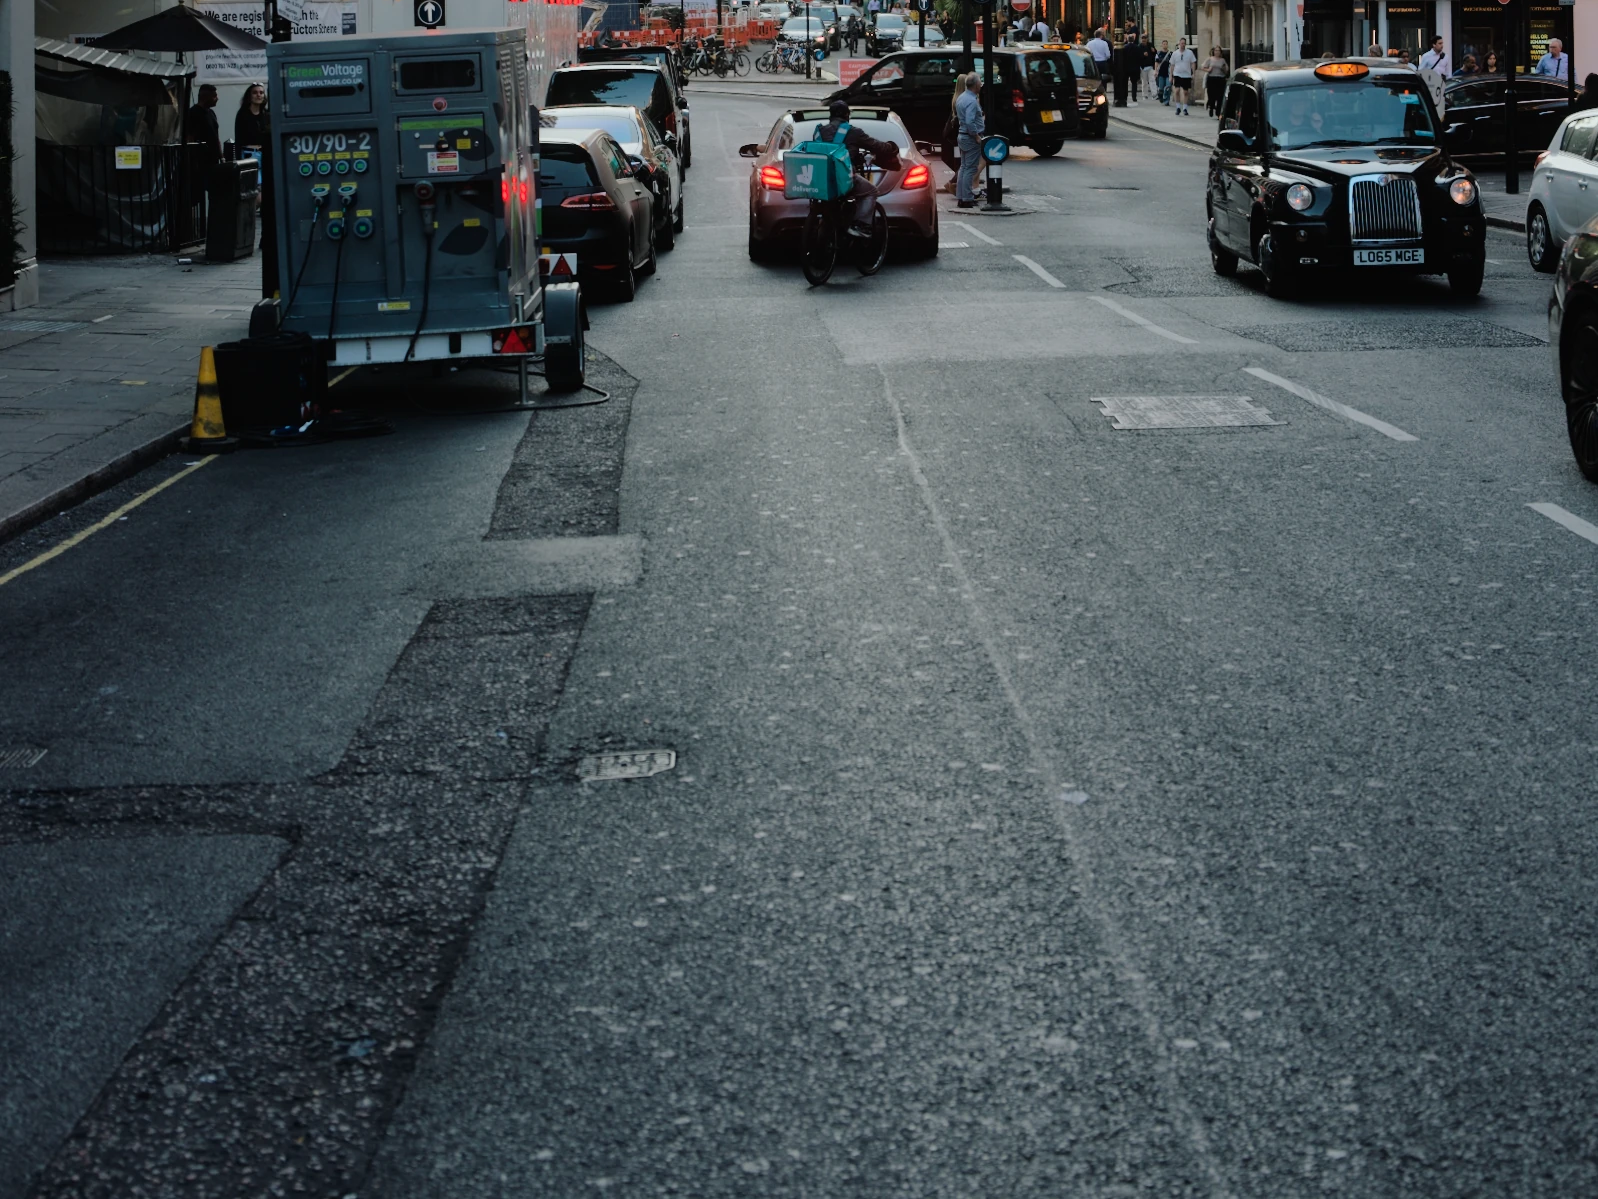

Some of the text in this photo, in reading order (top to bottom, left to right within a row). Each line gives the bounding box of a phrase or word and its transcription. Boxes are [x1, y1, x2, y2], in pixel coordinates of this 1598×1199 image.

[222, 13, 237, 21] are
[309, 10, 319, 20] the
[288, 64, 363, 78] GreenVoltage
[1328, 66, 1359, 74] TAXI
[289, 78, 363, 88] GREENVOLTAGE.CO.UK
[289, 132, 372, 154] 30/90-2
[792, 185, 819, 193] deliveroo
[1359, 249, 1420, 263] LO65 MGE
